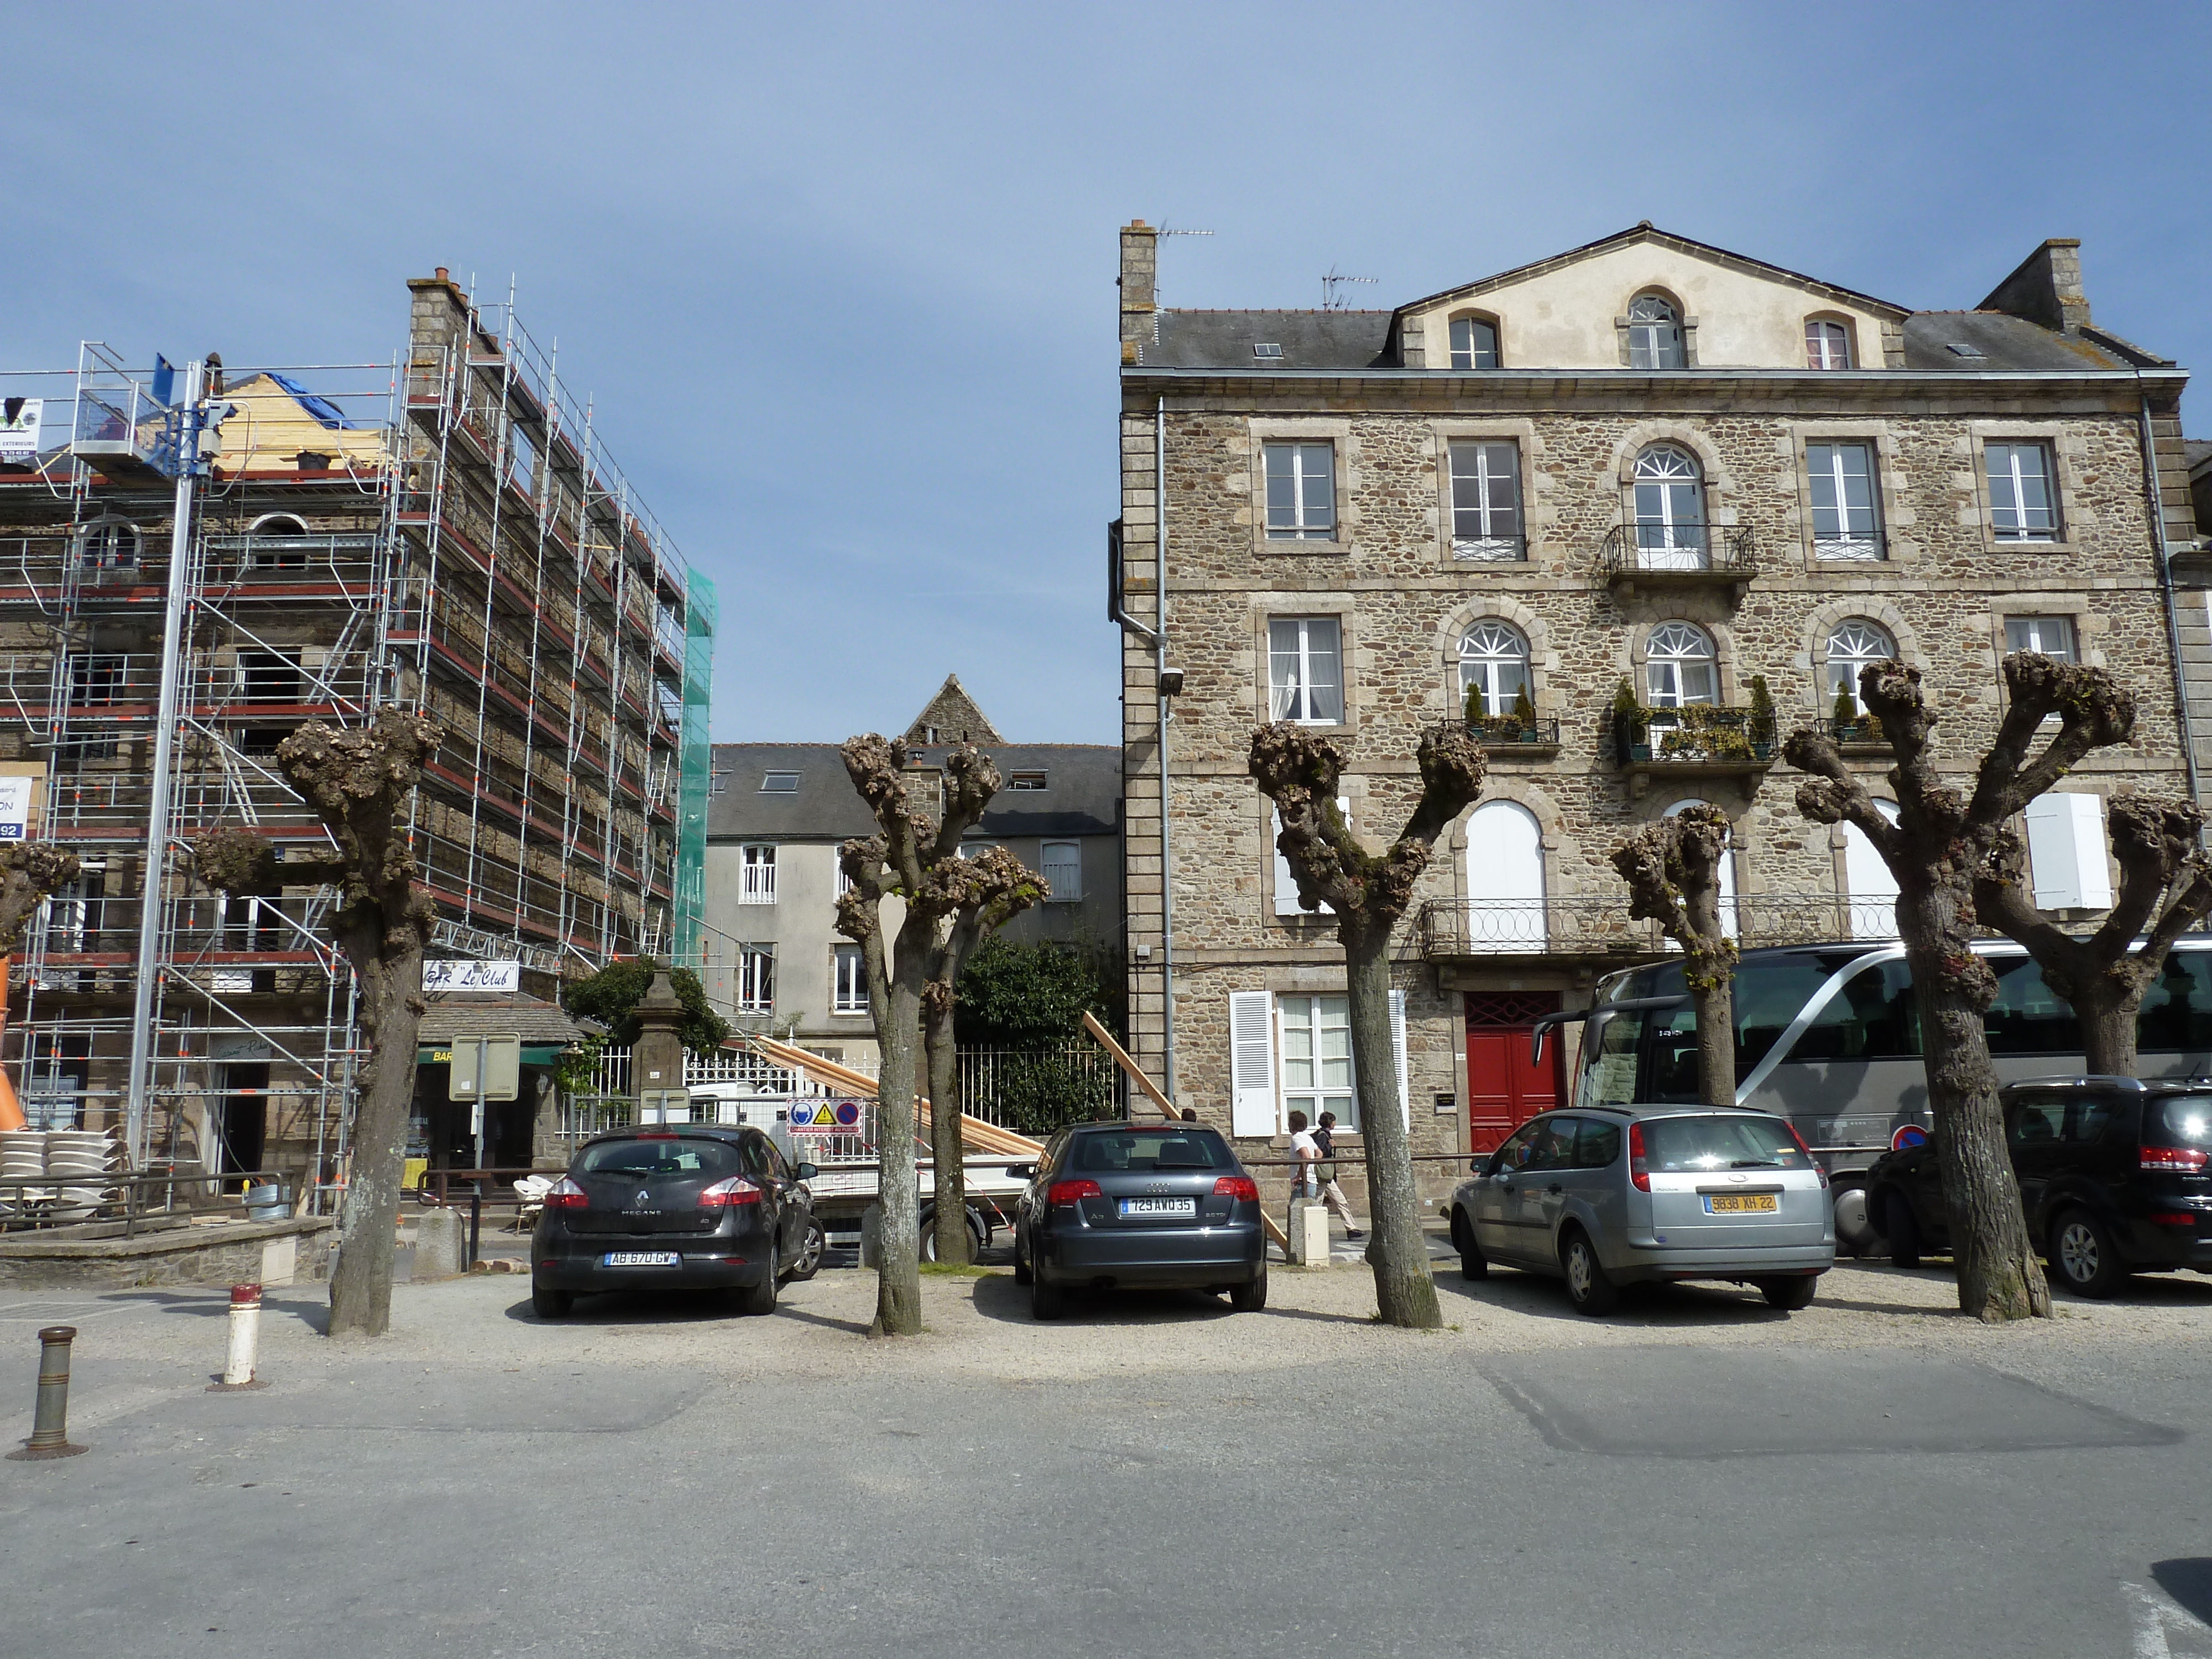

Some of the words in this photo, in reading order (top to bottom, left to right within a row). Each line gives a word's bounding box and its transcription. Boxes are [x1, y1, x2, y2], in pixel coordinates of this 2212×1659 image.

[1, 825, 17, 836] 92
[433, 1051, 452, 1061] BAR
[1133, 1199, 1152, 1211] 729
[1155, 1199, 1175, 1211] AWQ
[1177, 1198, 1190, 1211] 35
[1712, 1197, 1739, 1209] 9838
[1744, 1197, 1757, 1209] XH
[1760, 1197, 1775, 1208] 22
